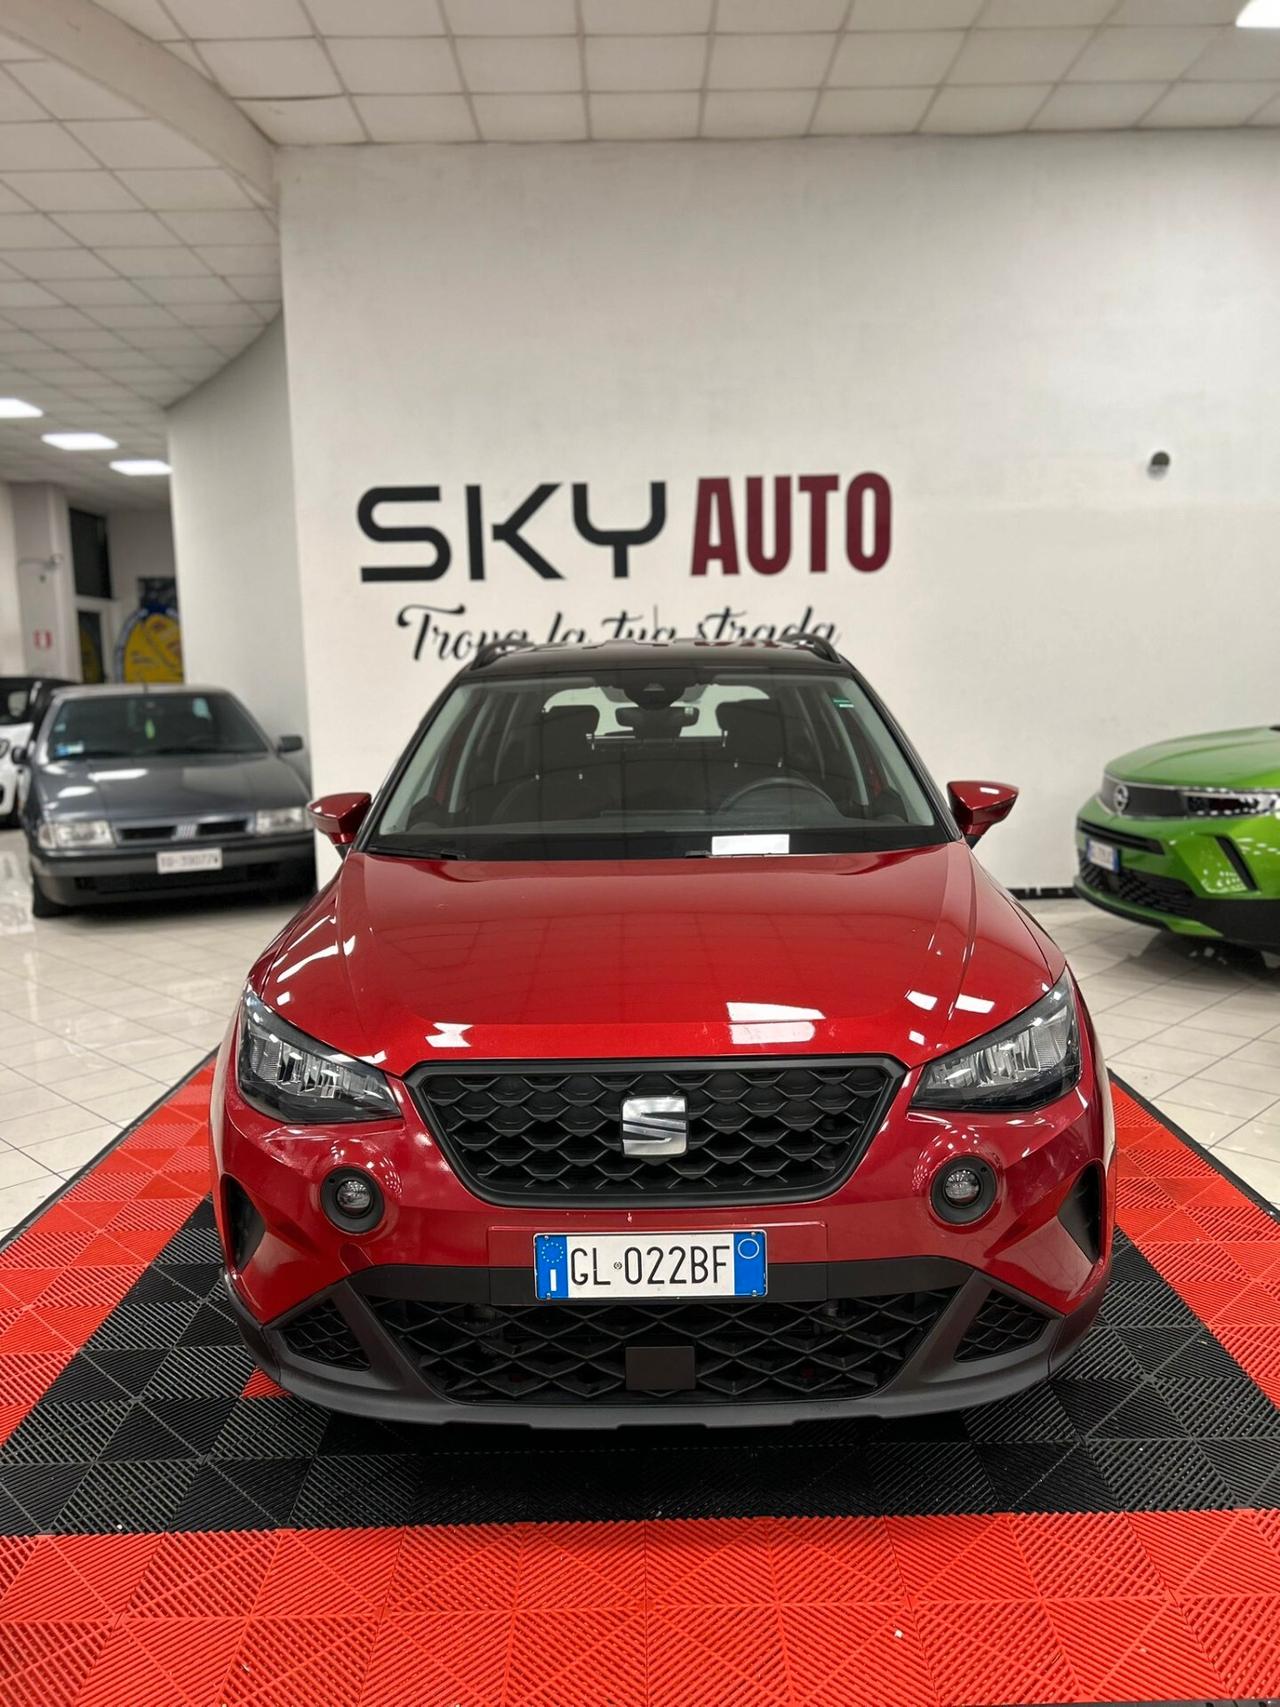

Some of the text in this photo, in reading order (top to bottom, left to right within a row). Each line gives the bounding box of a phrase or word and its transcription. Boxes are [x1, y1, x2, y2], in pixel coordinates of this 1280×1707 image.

[356, 471, 892, 583] SKY AUTO
[570, 1247, 612, 1286] GL
[624, 1245, 730, 1285] 022BF
